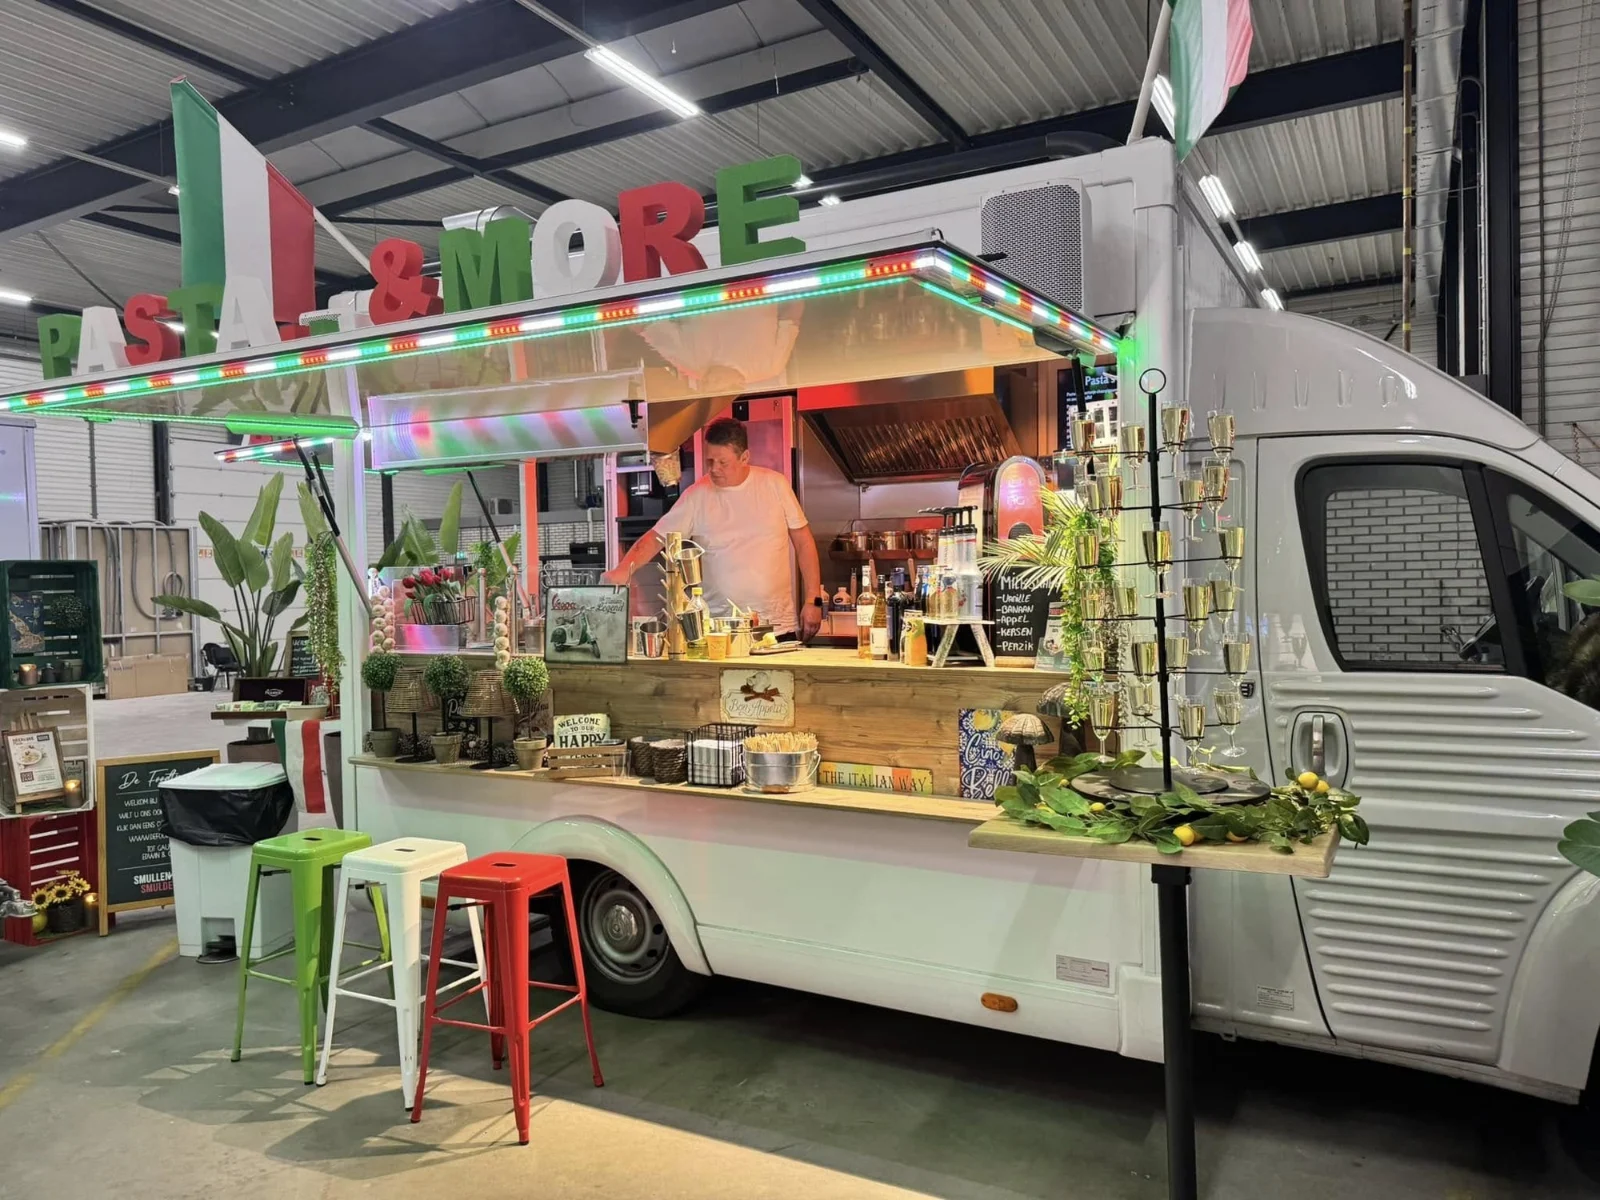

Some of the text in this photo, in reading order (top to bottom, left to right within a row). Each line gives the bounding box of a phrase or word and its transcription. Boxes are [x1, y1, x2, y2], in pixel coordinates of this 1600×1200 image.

[37, 275, 282, 380] PASTA
[558, 717, 601, 729] WELCOME
[559, 733, 606, 748] HAPPY
[965, 733, 1000, 764] Ciao
[118, 768, 181, 790] De Foodt
[823, 770, 927, 792] THE ITALIAN WAY
[962, 766, 1011, 800] Bell
[134, 810, 139, 818] U
[141, 809, 152, 817] ONS
[129, 822, 141, 830] DAN
[142, 821, 155, 829] EENS
[157, 843, 170, 852] GAU
[141, 880, 173, 893] SMULDE
